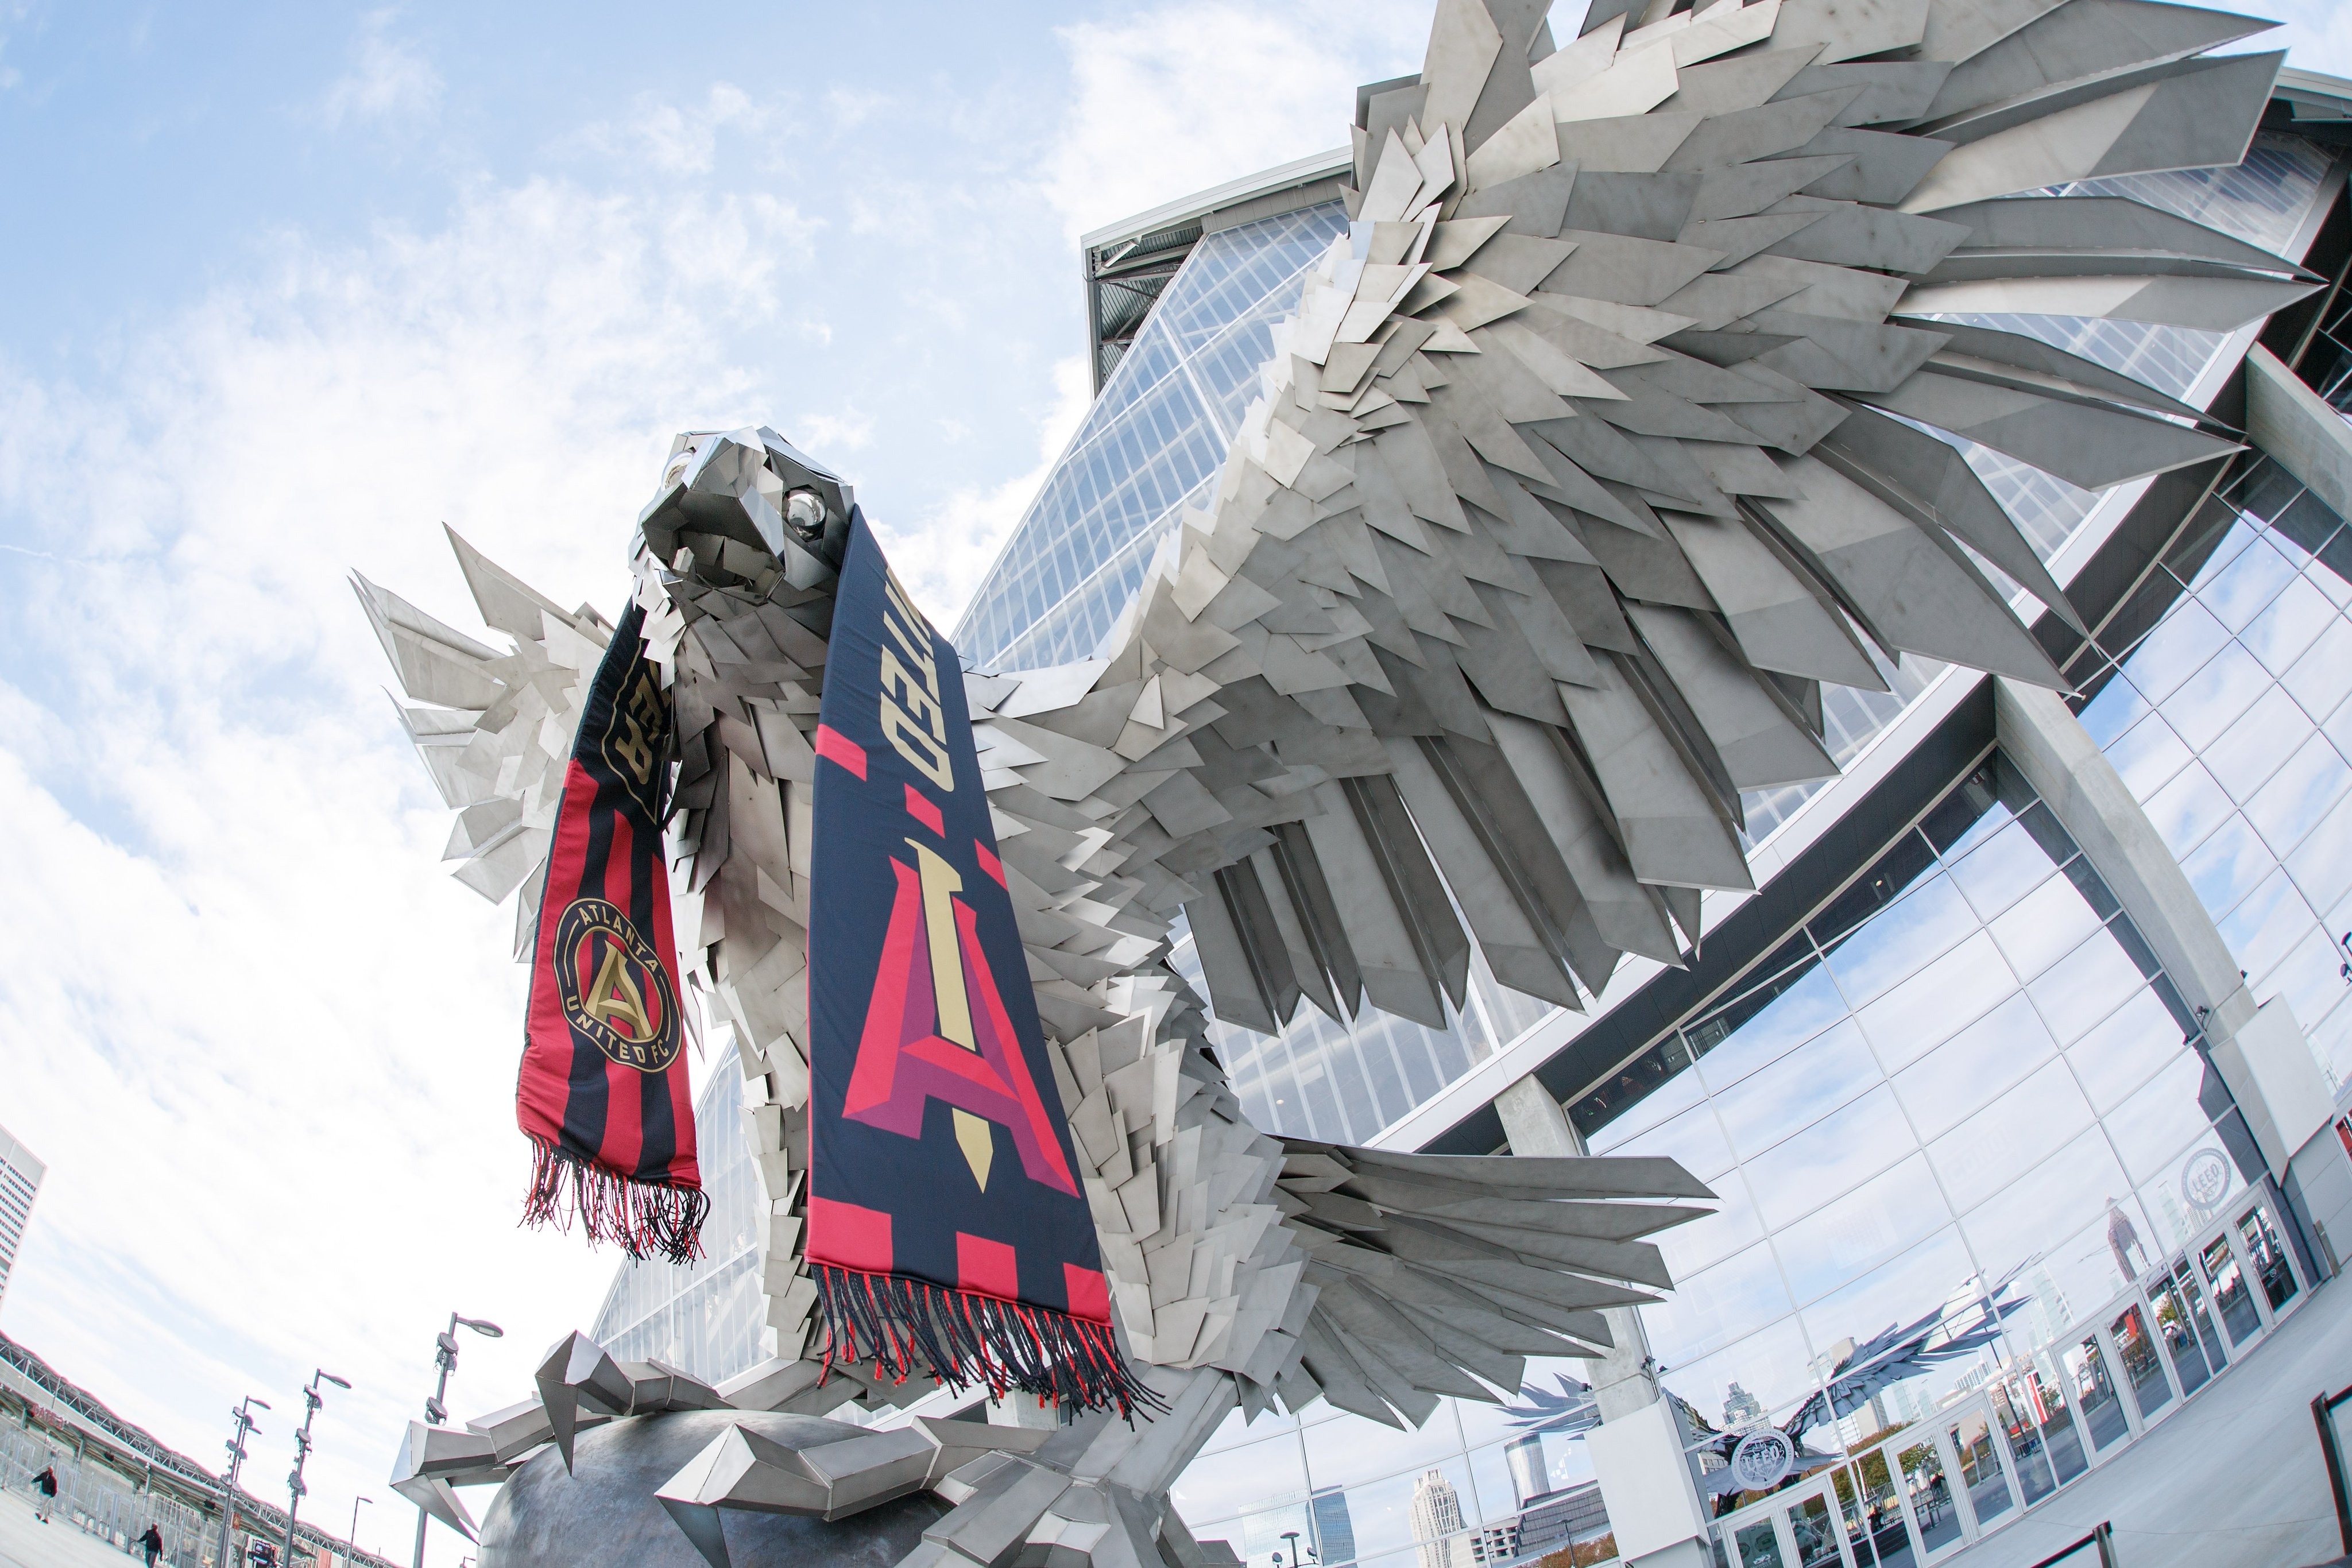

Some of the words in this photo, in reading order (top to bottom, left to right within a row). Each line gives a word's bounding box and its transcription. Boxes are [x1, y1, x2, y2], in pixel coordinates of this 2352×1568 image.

[578, 904, 659, 973] ATLANTA
[567, 995, 647, 1064] UNITED
[651, 1039, 669, 1064] FC
[2192, 1163, 2219, 1193] LEED
[1744, 1445, 1780, 1473] LEED
